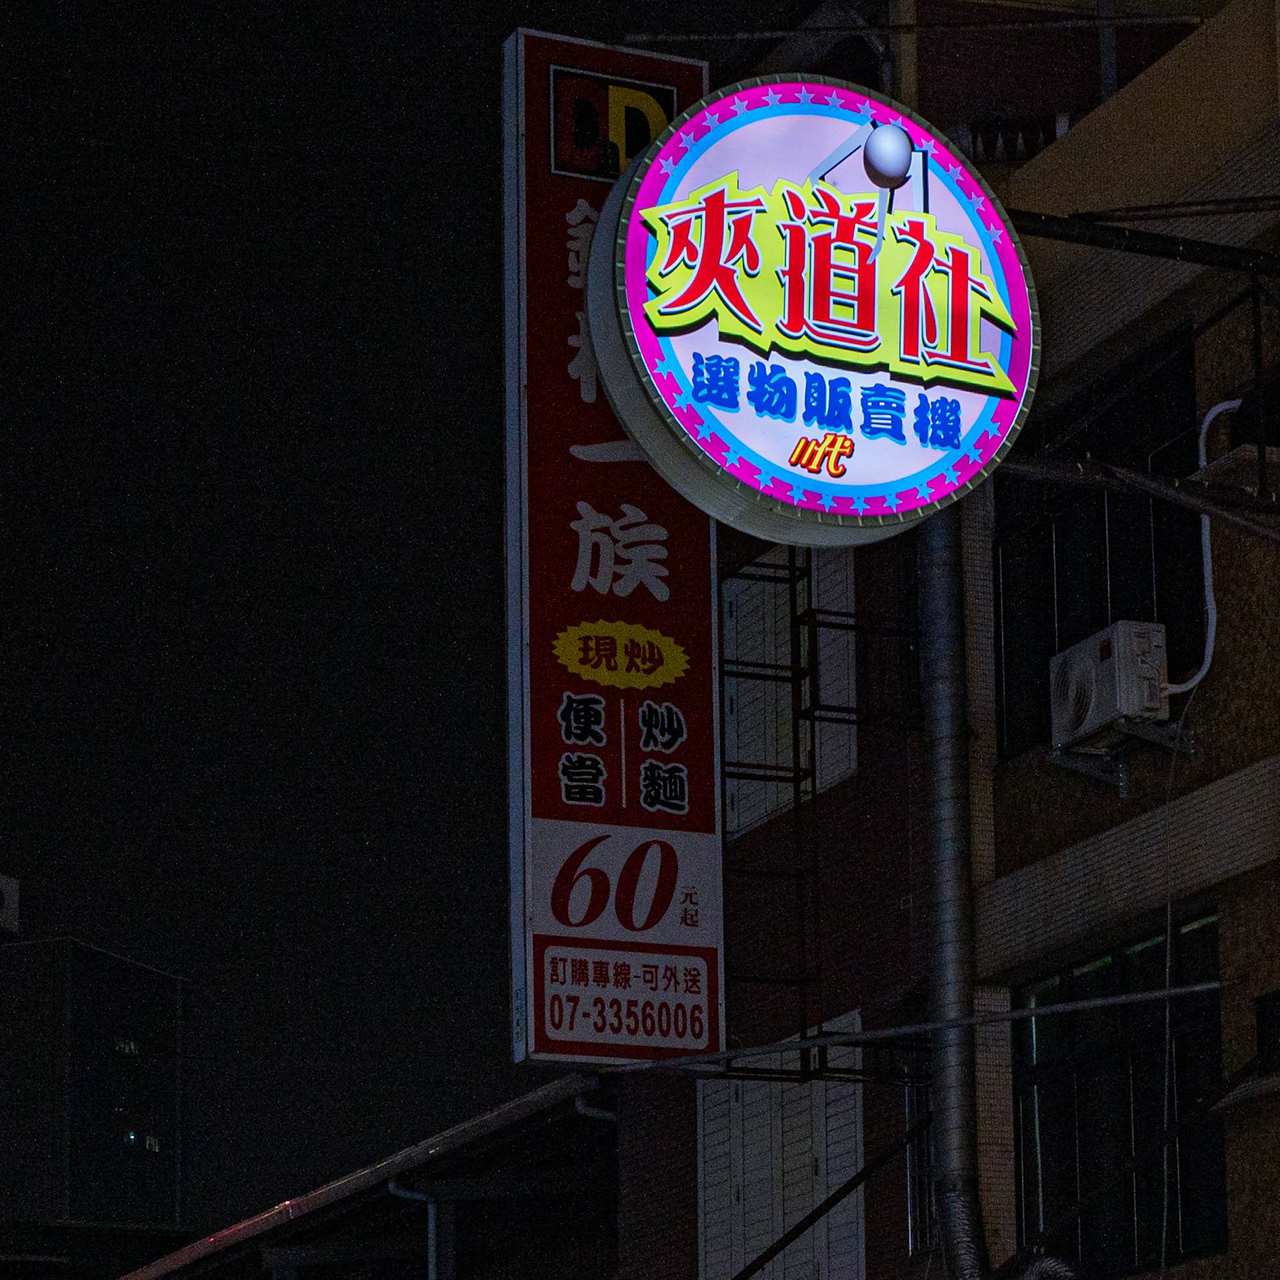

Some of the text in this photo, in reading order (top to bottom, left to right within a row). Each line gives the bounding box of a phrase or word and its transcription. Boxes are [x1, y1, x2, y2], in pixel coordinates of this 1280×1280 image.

[658, 185, 995, 376] 夾道社
[690, 352, 964, 450] 選物販賣機
[577, 634, 665, 675] 現炒
[560, 693, 606, 806] 便當
[640, 700, 688, 812] 炒麵
[550, 834, 679, 932] 60
[679, 885, 700, 928] 元起
[549, 994, 705, 1040] 07-3356006
